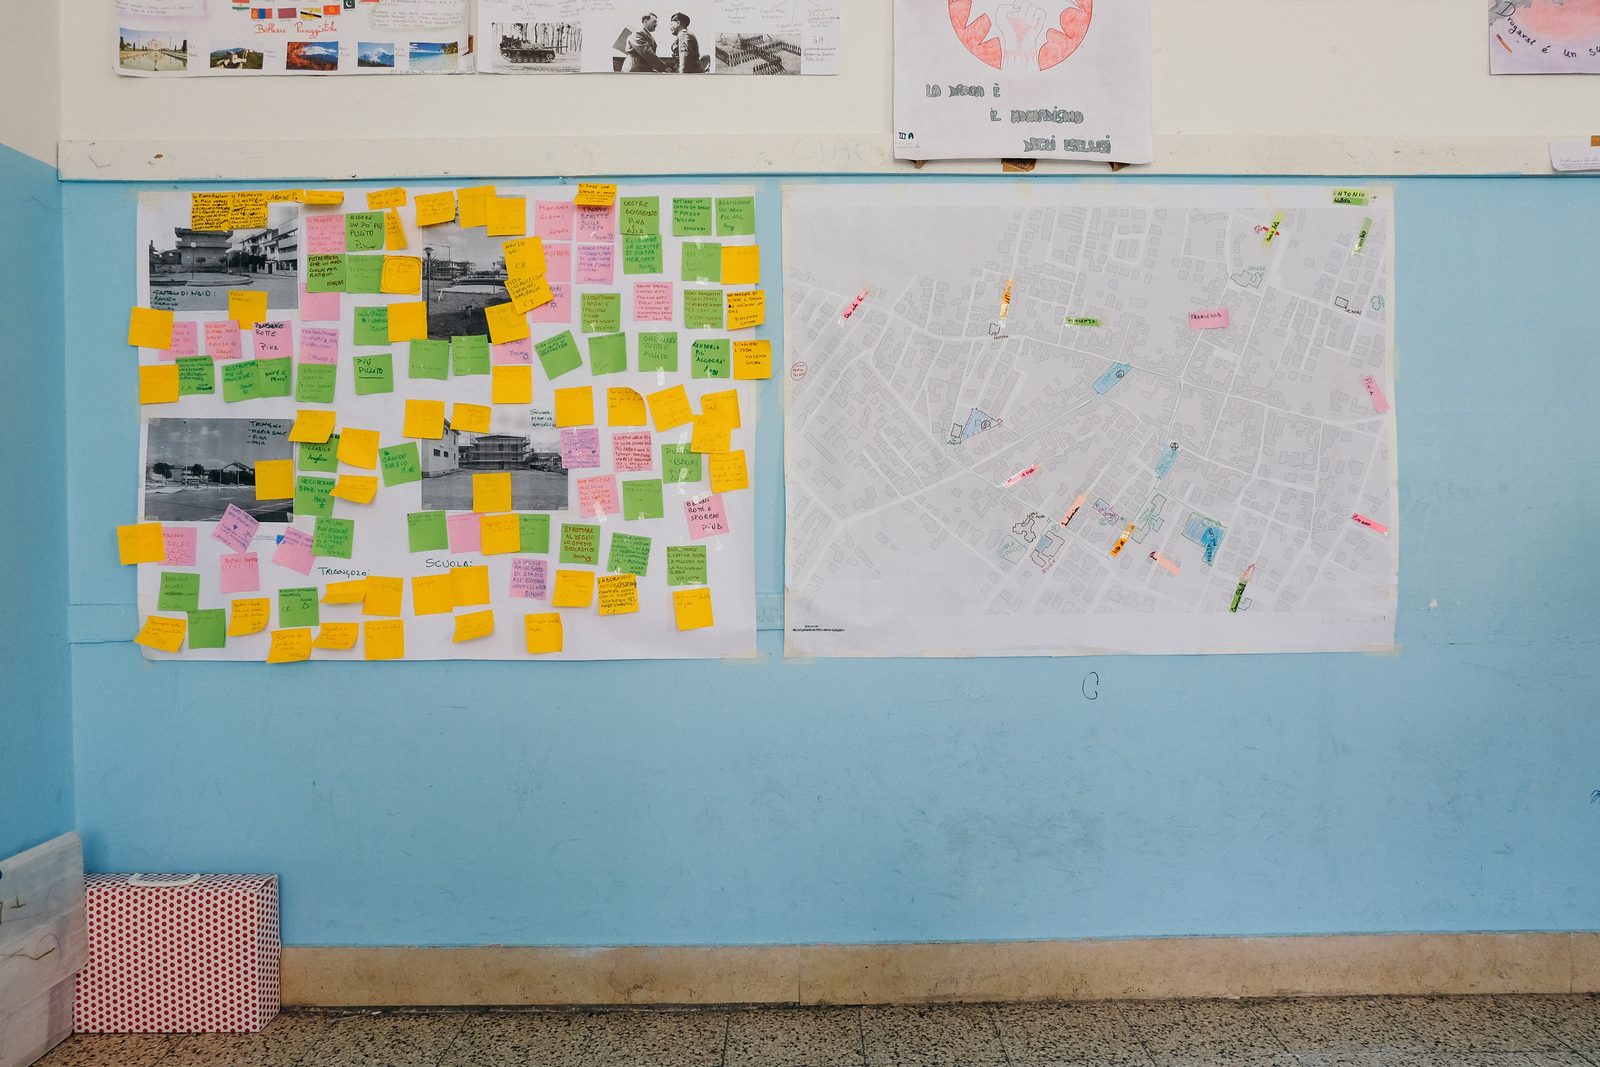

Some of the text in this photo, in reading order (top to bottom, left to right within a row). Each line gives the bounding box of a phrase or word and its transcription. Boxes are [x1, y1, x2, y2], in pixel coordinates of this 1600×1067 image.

[1564, 49, 1577, 58] un
[926, 83, 1001, 98] LA DROGA È
